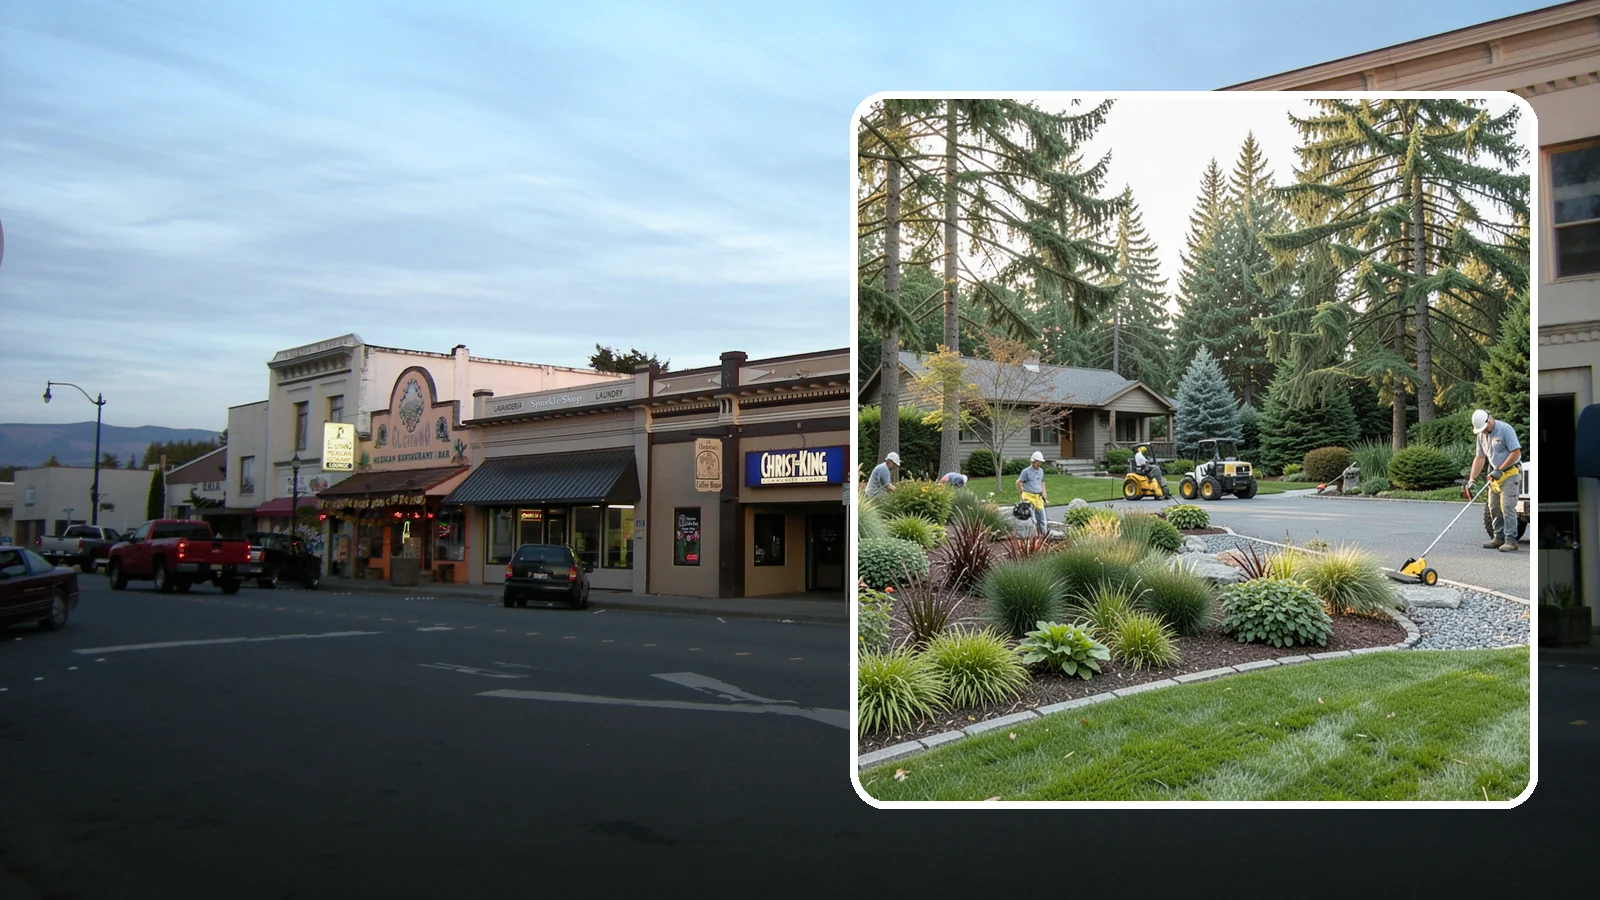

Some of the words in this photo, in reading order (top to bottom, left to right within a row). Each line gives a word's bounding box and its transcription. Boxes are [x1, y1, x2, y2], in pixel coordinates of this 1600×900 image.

[531, 395, 561, 409] Sparkle
[561, 393, 583, 405] Shop
[595, 389, 623, 400] LAUNDRY
[493, 402, 523, 412] LAVANDERIA
[374, 454, 396, 464] MEXICAN
[397, 451, 433, 462] RESTAURANT
[438, 450, 450, 459] BAR
[761, 452, 797, 477] CHRIST
[799, 450, 827, 476] KING
